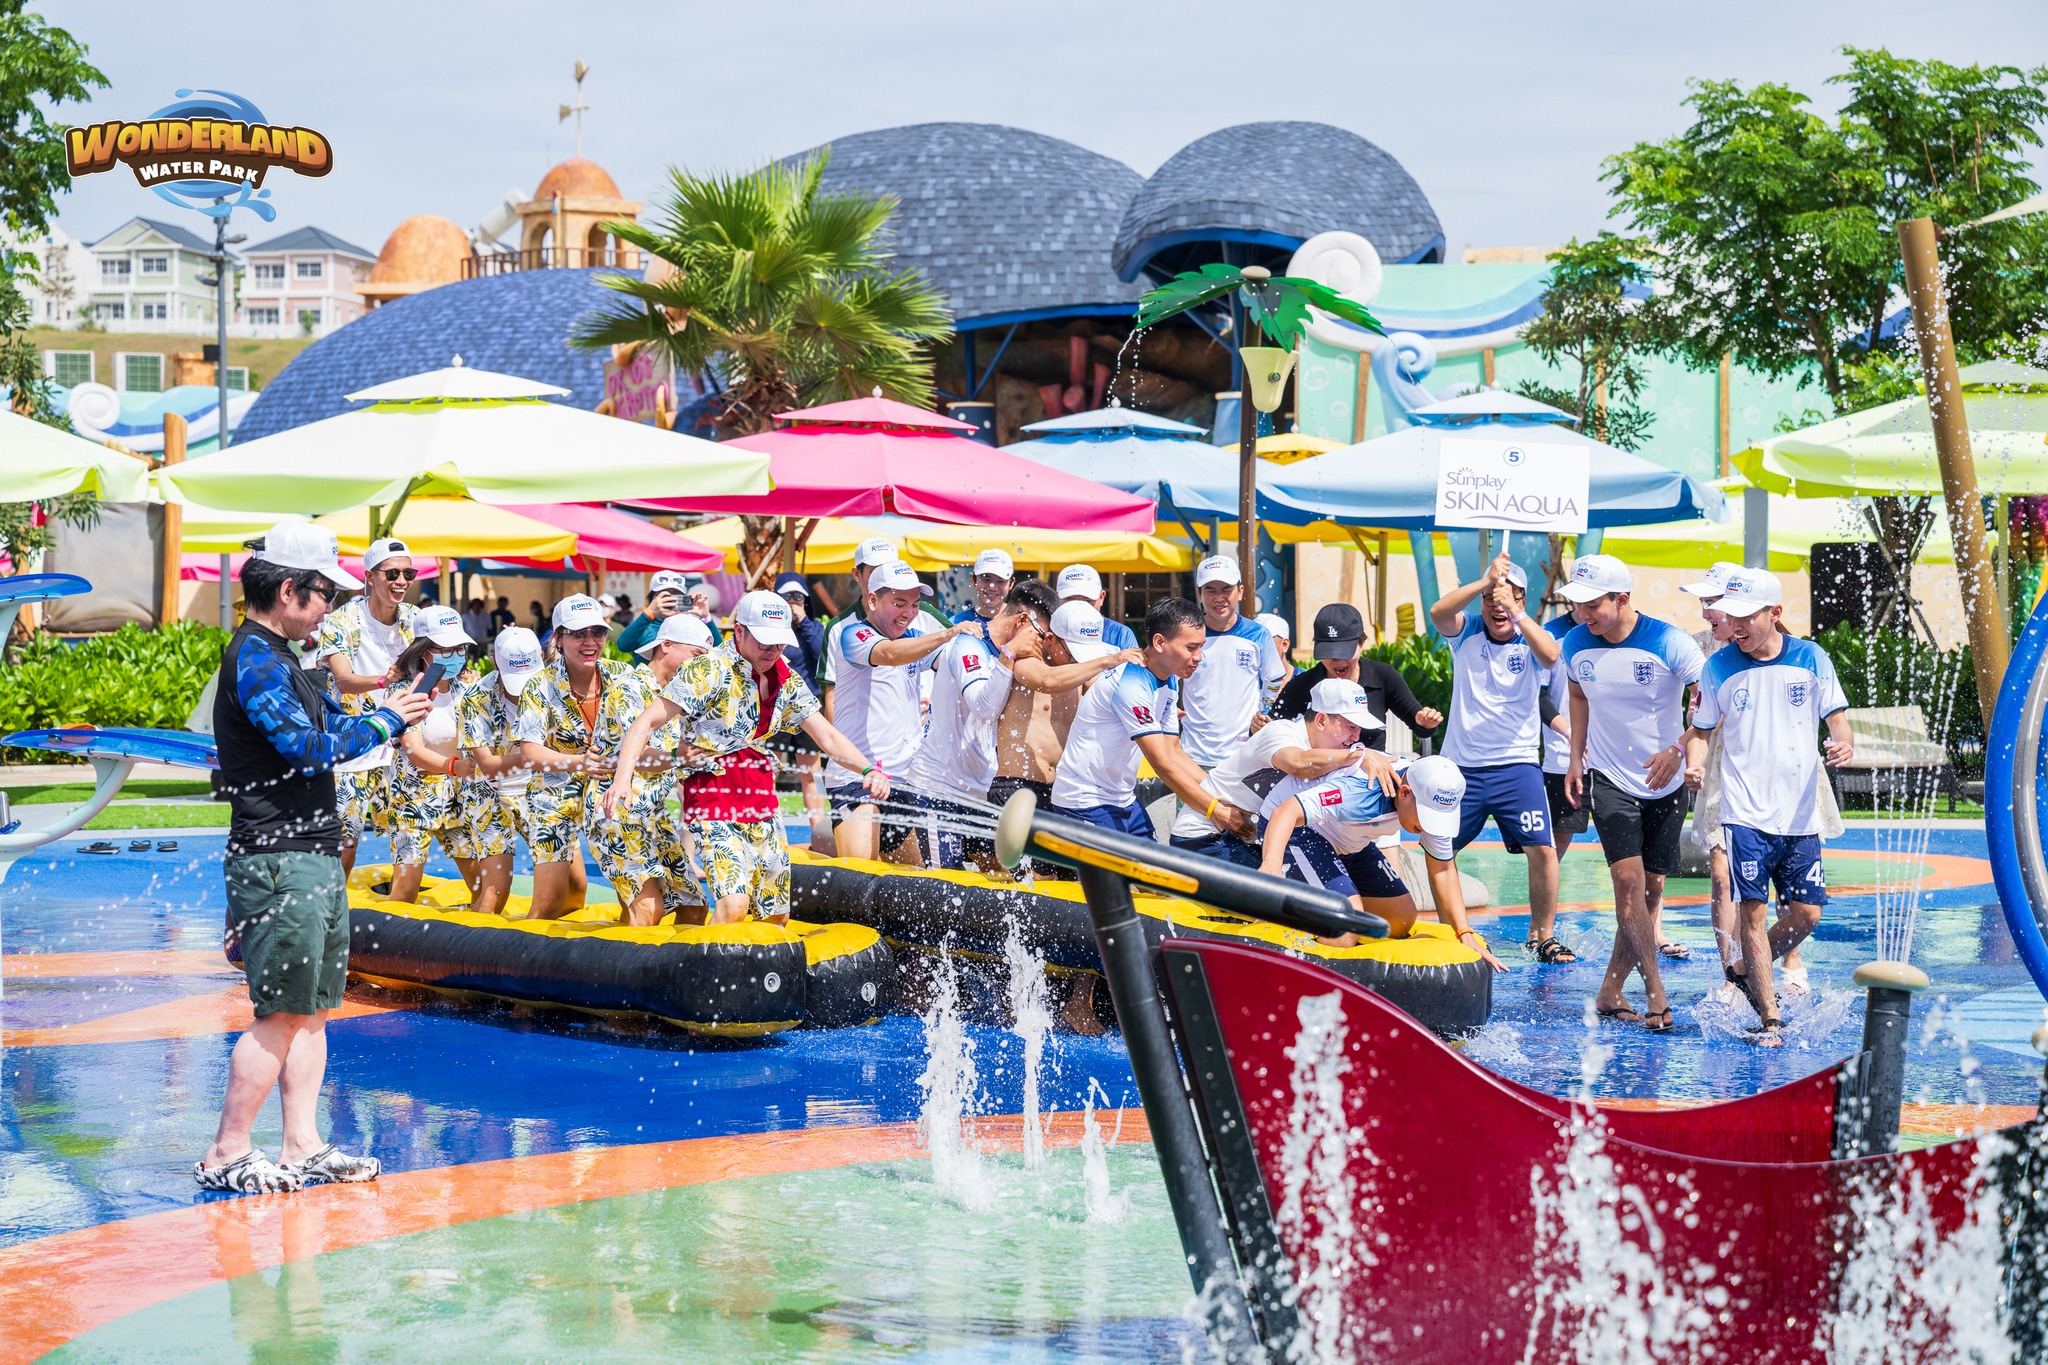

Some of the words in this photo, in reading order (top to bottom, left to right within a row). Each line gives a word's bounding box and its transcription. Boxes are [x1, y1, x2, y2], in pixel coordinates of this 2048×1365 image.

[1508, 451, 1520, 463] 5
[1446, 470, 1507, 491] Sunplay
[1444, 490, 1499, 510] SKIN
[1503, 494, 1579, 517] AQUA
[762, 609, 784, 618] ROHTO
[509, 657, 532, 667] ROHTO
[1432, 794, 1457, 804] ROHTO
[1520, 810, 1545, 832] 95
